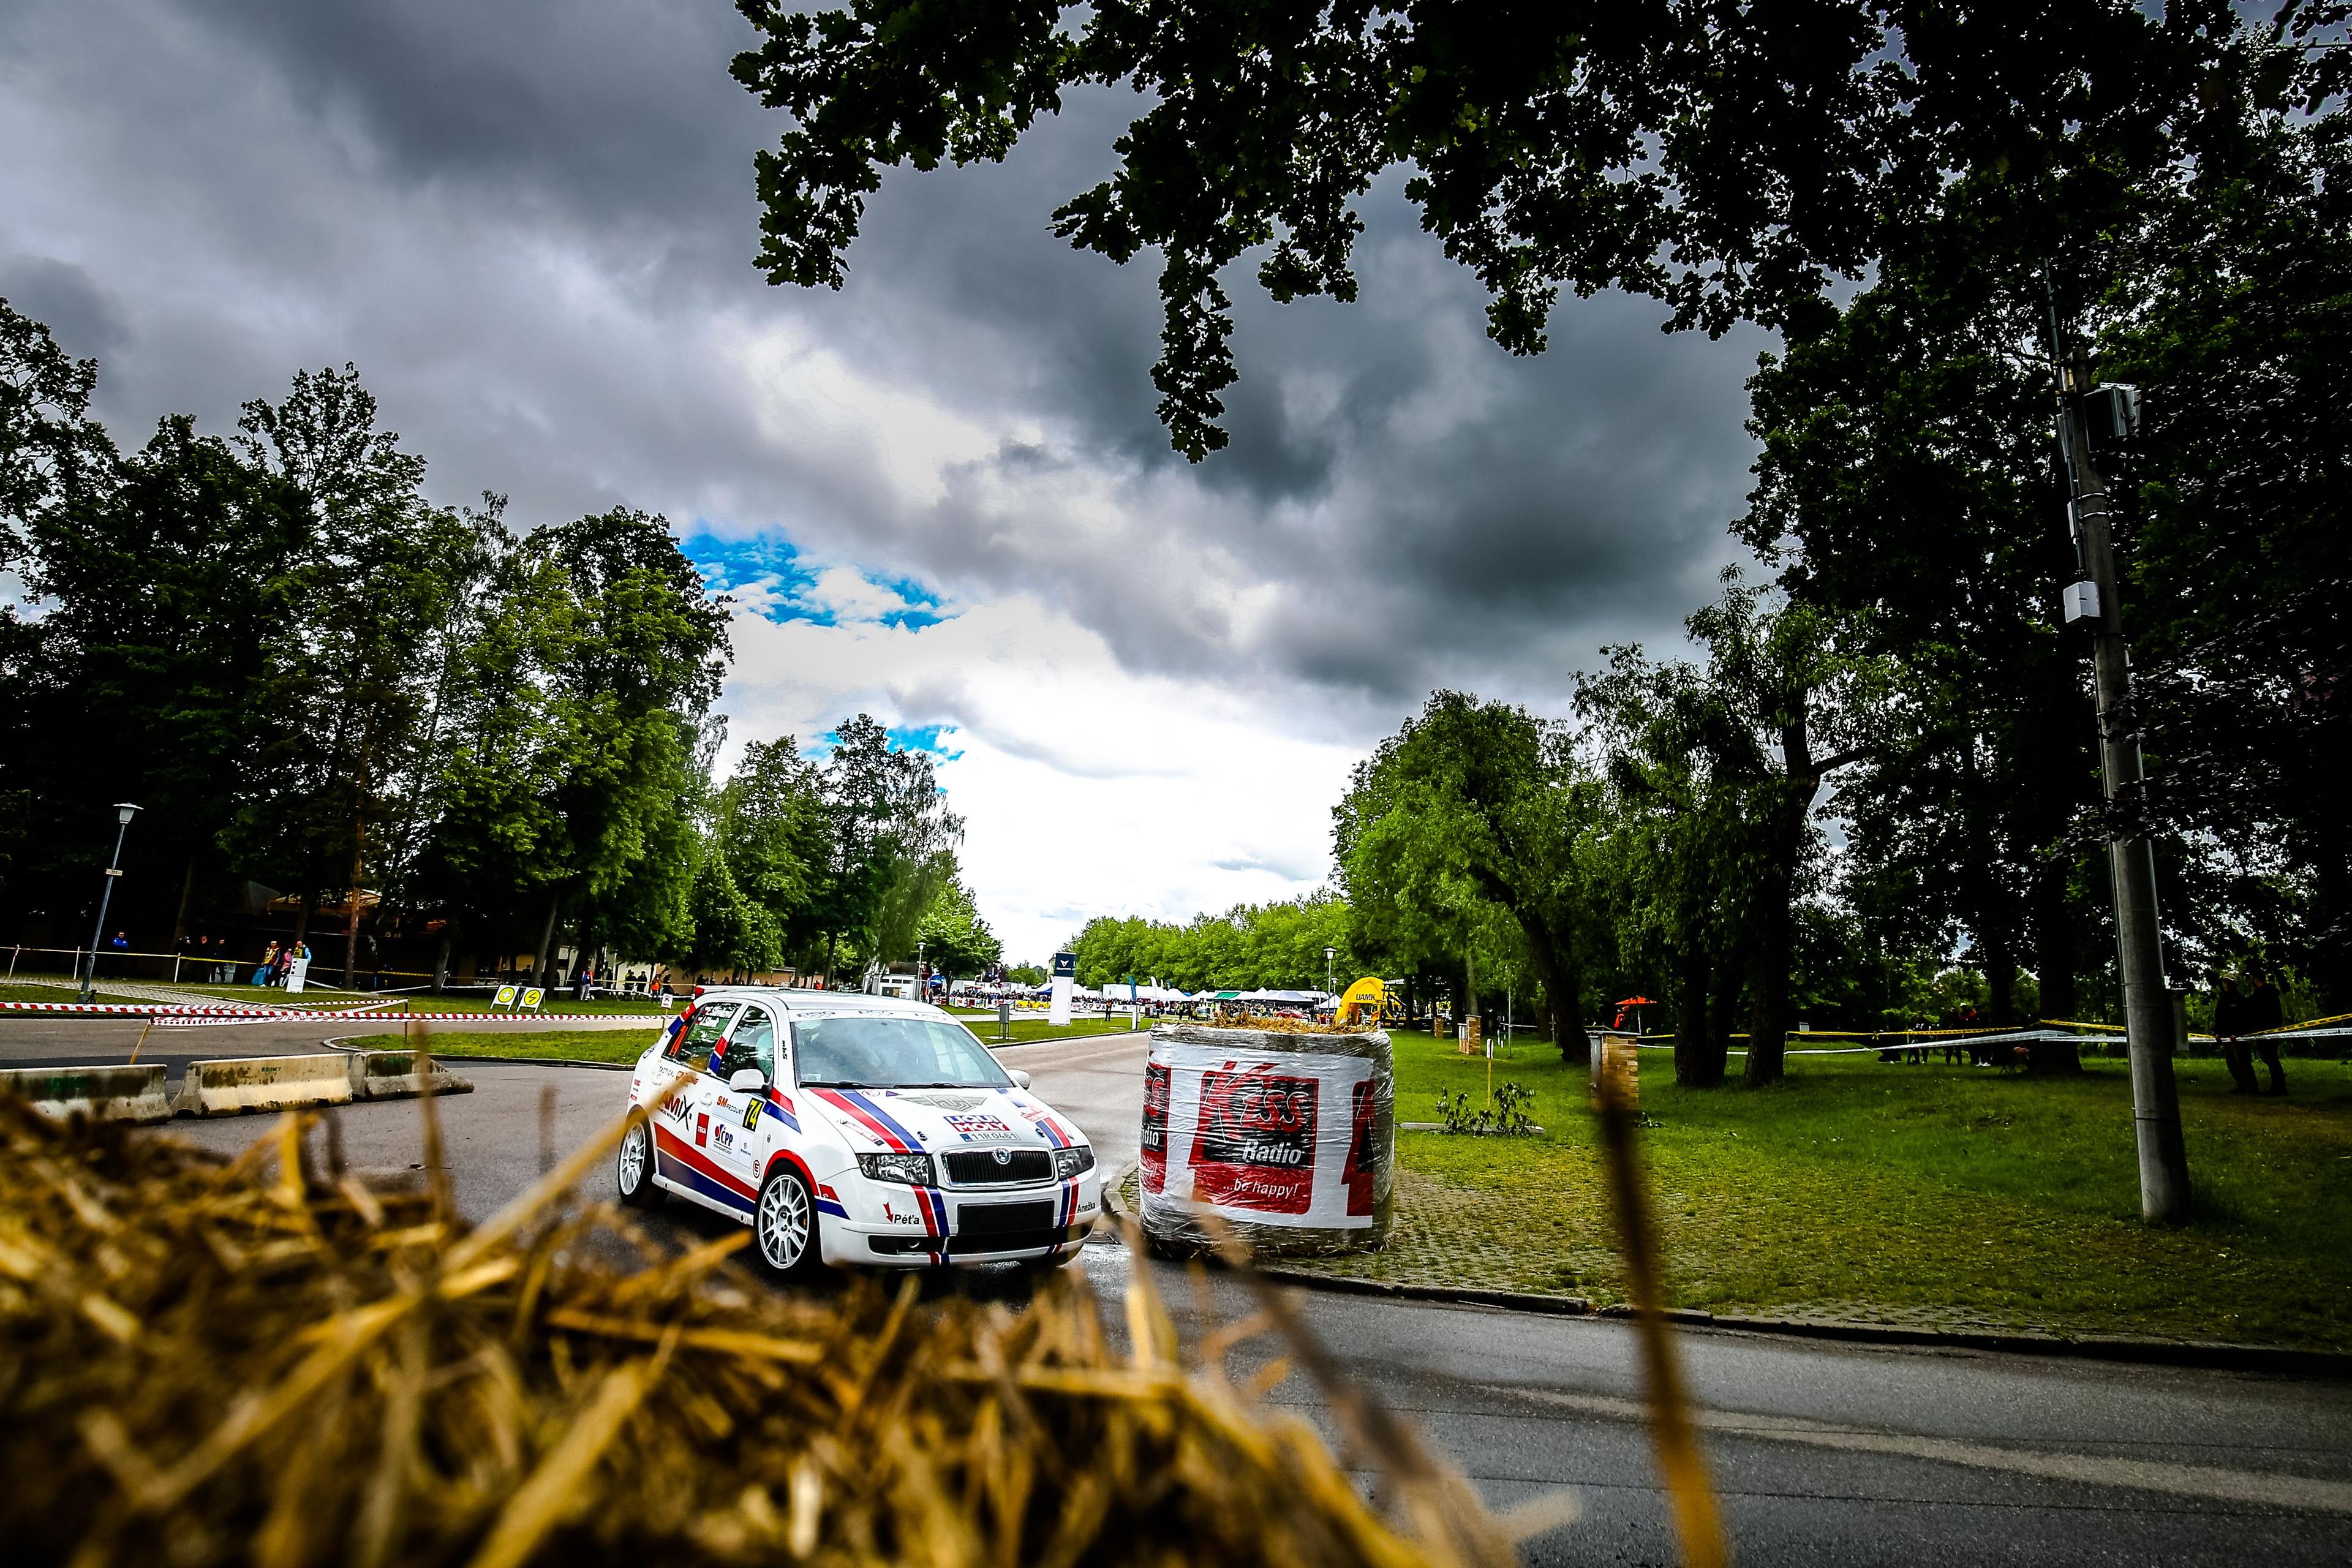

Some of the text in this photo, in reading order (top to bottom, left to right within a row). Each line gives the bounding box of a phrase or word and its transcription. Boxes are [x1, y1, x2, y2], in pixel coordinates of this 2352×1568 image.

[717, 1095, 728, 1108] SM
[744, 1099, 762, 1129] 74
[953, 1123, 1006, 1131] MOLY
[721, 1127, 733, 1147] ČPP
[1242, 1138, 1302, 1164] Radio
[1252, 1180, 1299, 1199] happy!
[894, 1214, 919, 1224] Péťa
